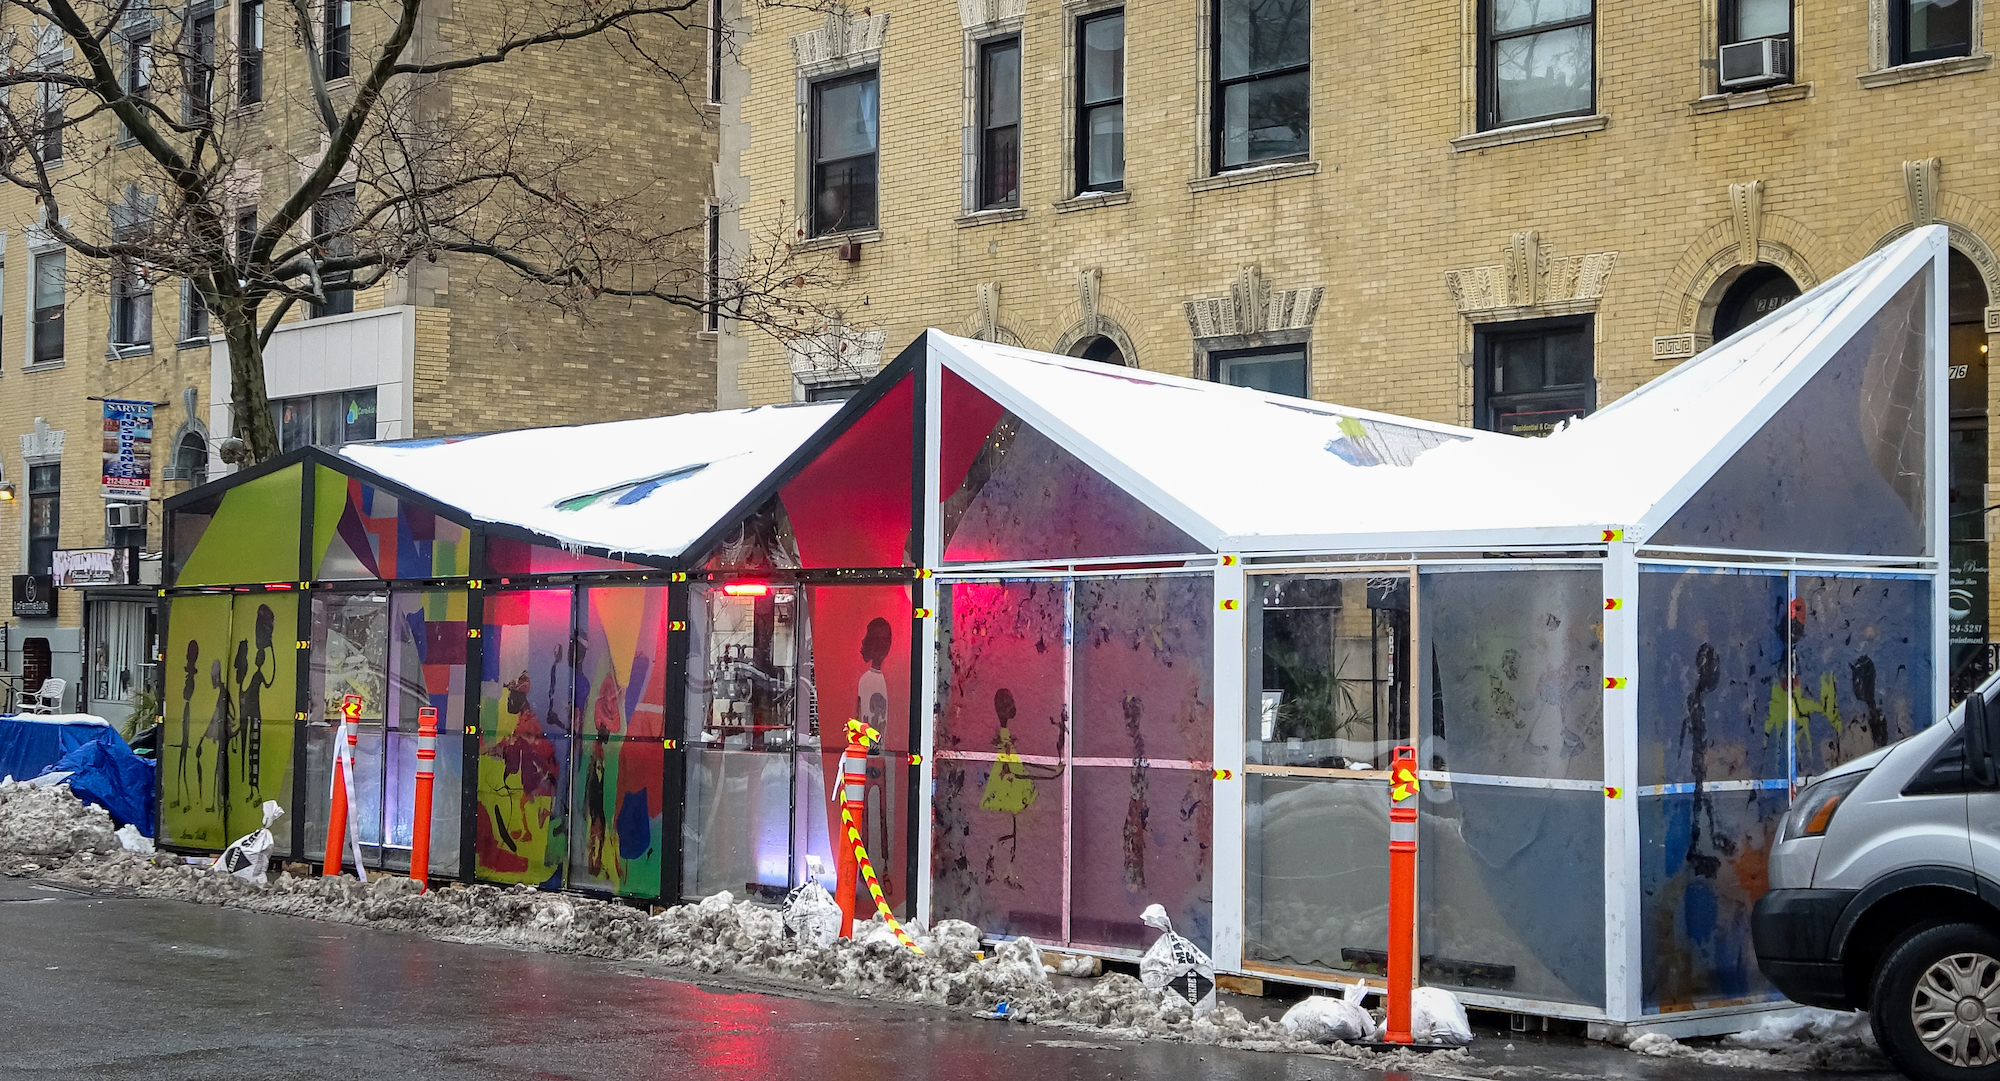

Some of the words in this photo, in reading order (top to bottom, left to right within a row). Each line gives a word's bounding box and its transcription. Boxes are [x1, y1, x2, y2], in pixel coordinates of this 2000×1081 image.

[1757, 295, 1799, 312] 237
[1949, 366, 1967, 378] 76
[108, 404, 149, 413] SARVIS
[120, 413, 135, 478] INSURANCE
[1949, 624, 1983, 633] 24-5281
[1949, 636, 1984, 646] pointment
[1187, 971, 1197, 1003] SAKREE
